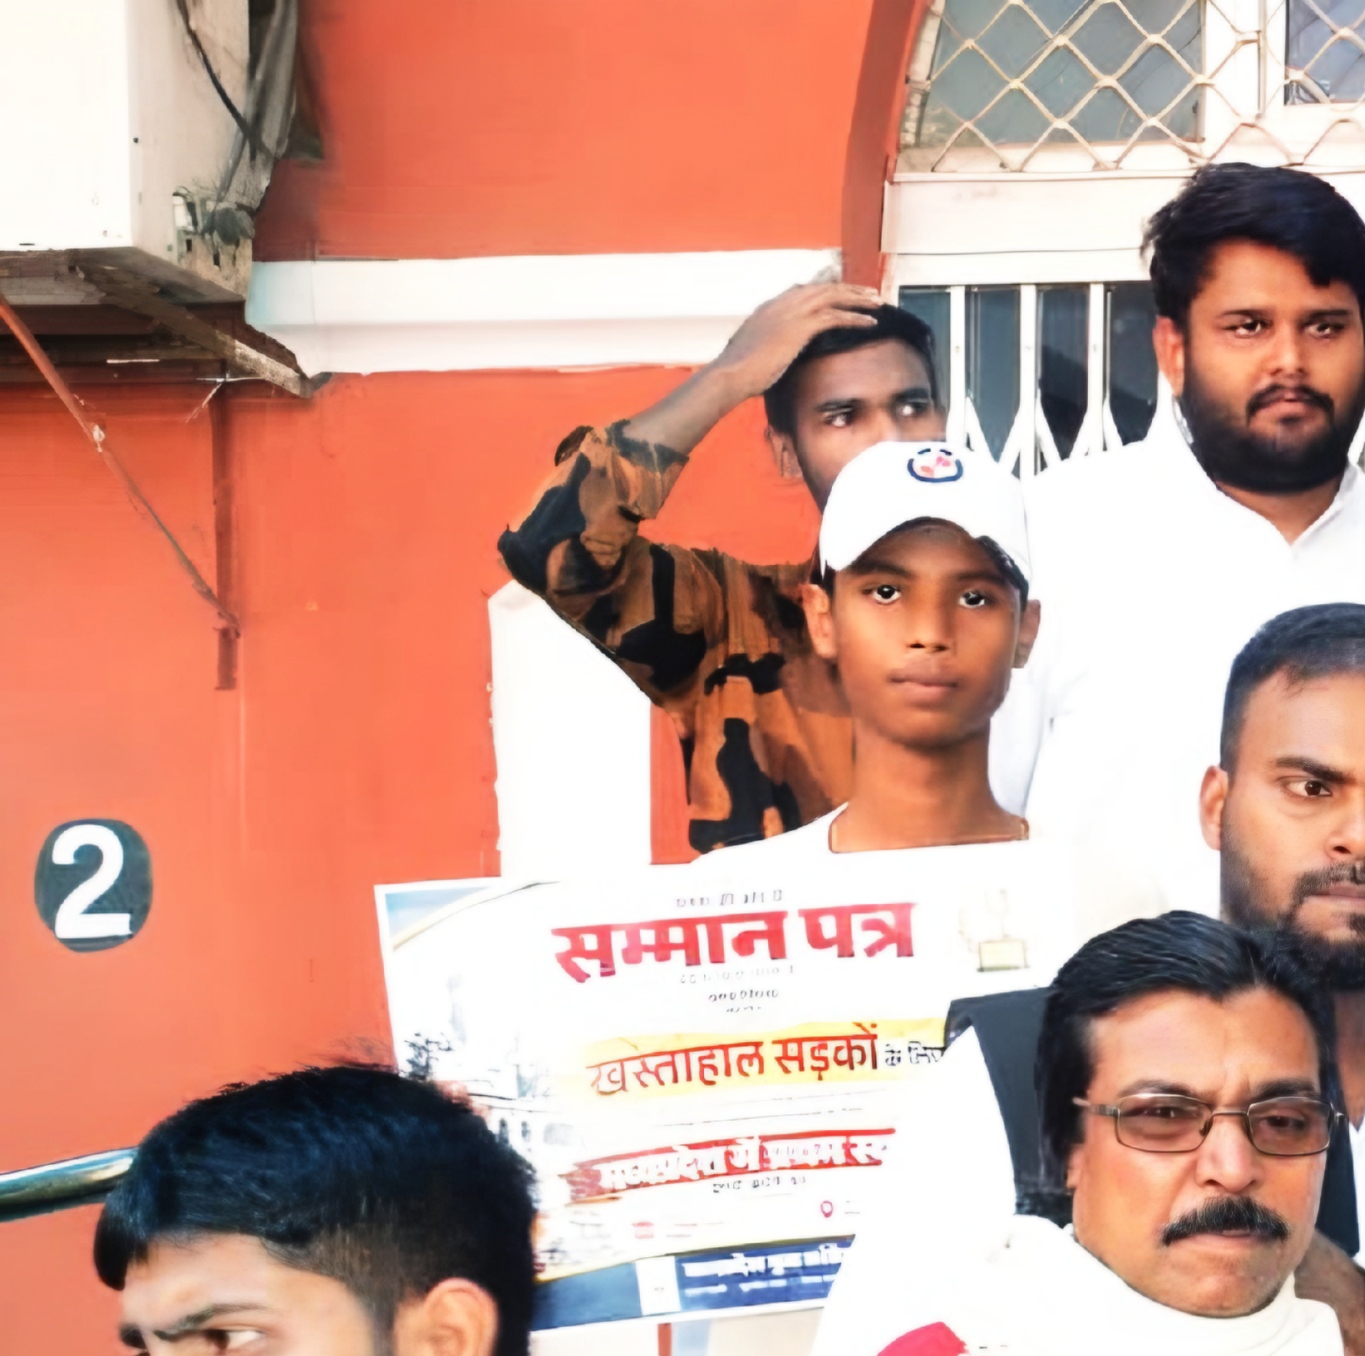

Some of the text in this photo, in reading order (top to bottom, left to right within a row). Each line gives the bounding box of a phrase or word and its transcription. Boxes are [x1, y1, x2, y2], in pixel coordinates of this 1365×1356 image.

[52, 824, 133, 939] 2
[551, 902, 918, 983] सम्मान पत्र
[586, 1040, 764, 1096] खस्ताहाल
[771, 1022, 878, 1081] सड़कों
